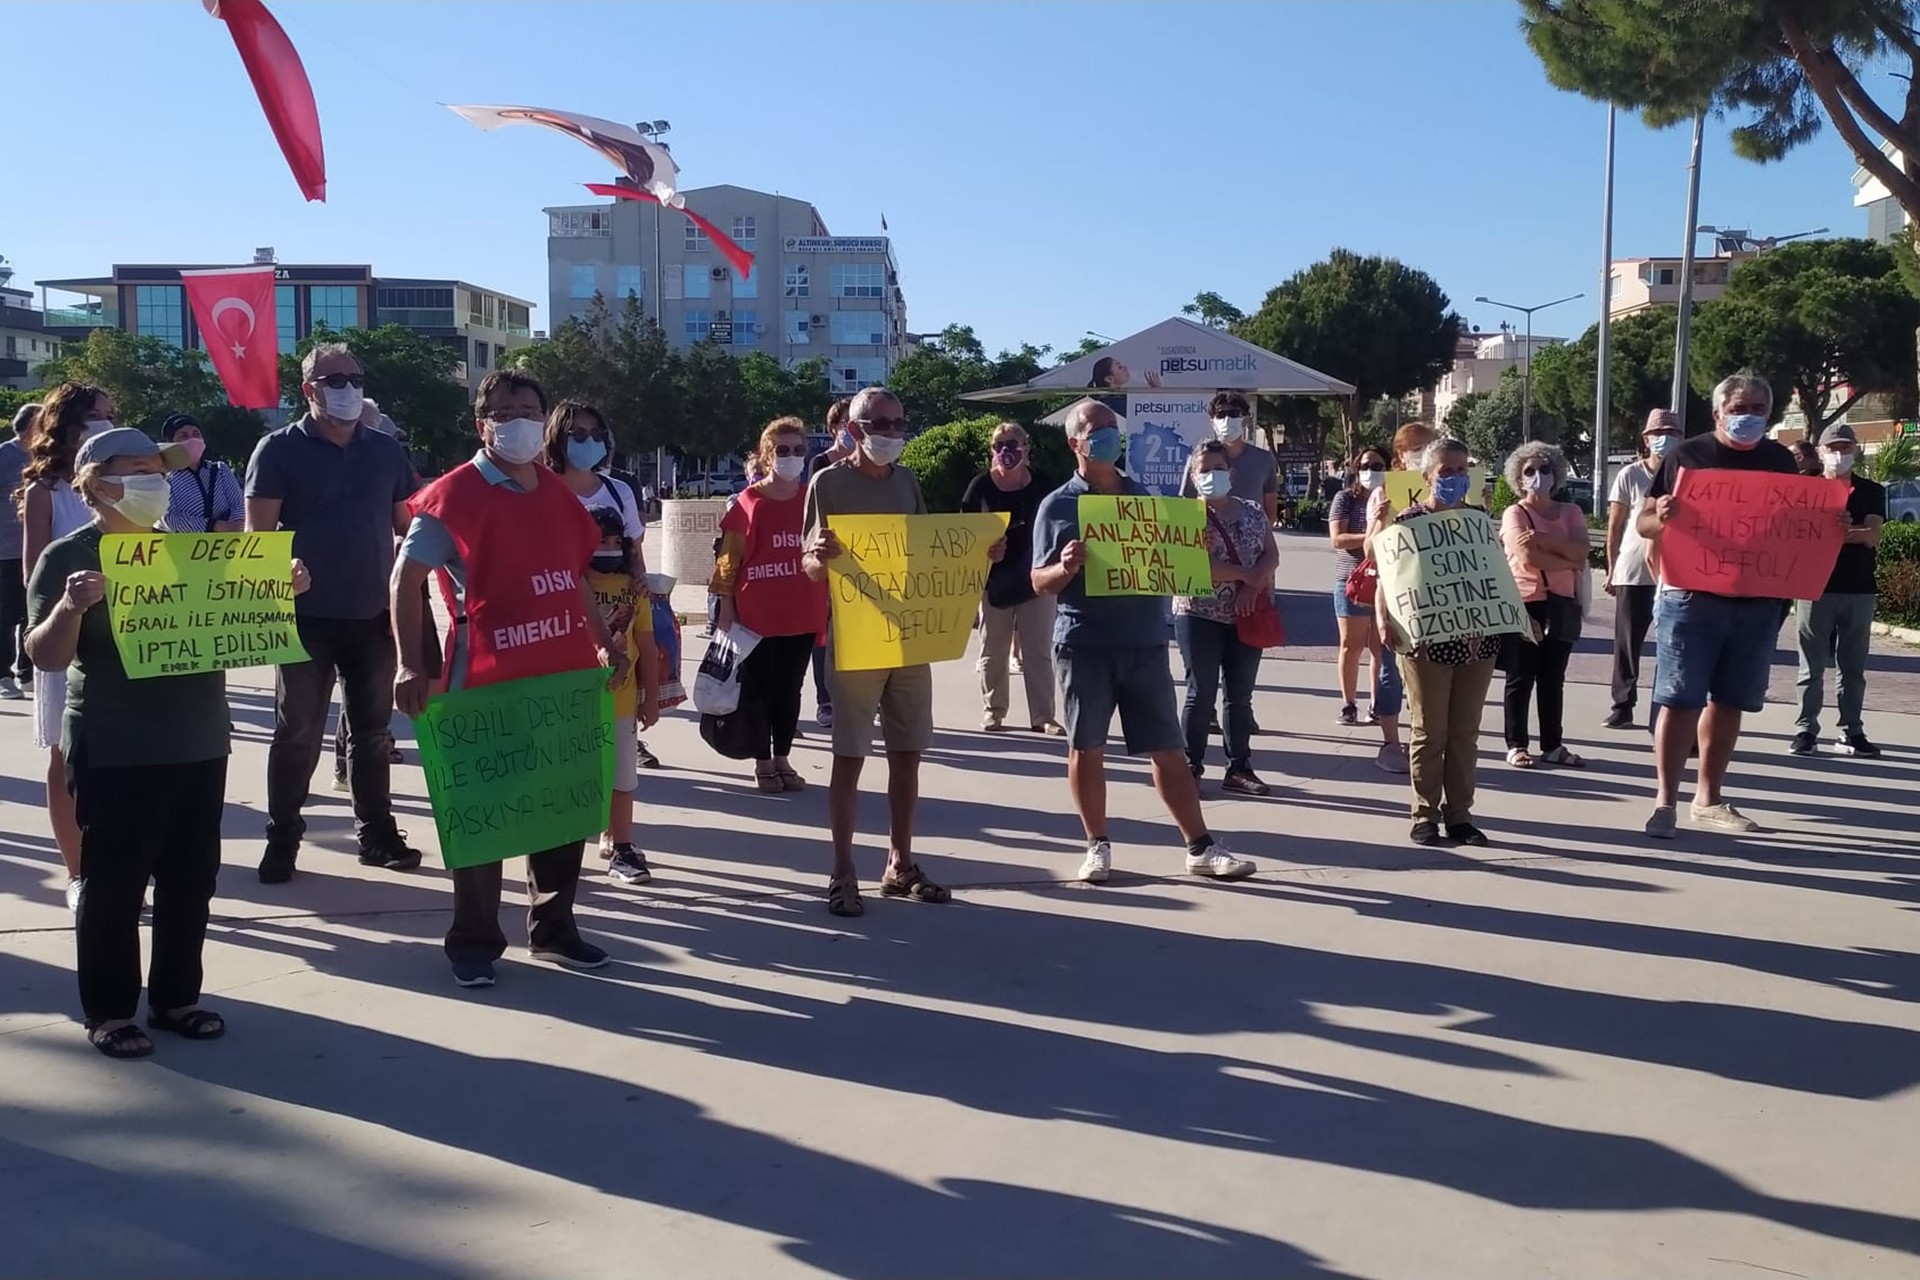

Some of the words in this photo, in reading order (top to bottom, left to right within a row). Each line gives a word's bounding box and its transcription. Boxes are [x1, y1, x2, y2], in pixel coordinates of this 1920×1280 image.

[275, 270, 290, 279] ZA
[1160, 354, 1257, 377] petsumatik
[1134, 400, 1208, 416] petsumatik
[1145, 434, 1162, 463] 2
[1165, 446, 1183, 463] TL
[1143, 473, 1183, 485] SUYUN
[115, 540, 163, 567] LAF
[929, 527, 977, 558] ABD
[1121, 543, 1175, 569] İPTAL
[747, 558, 797, 580] EMEKLİ
[207, 575, 295, 601] İSTİYORUZ
[531, 569, 576, 596] DİSK
[593, 591, 611, 605] ZIL
[188, 612, 214, 627] İLE
[493, 609, 571, 651] EMEKLİ
[138, 640, 203, 664] İPTAL
